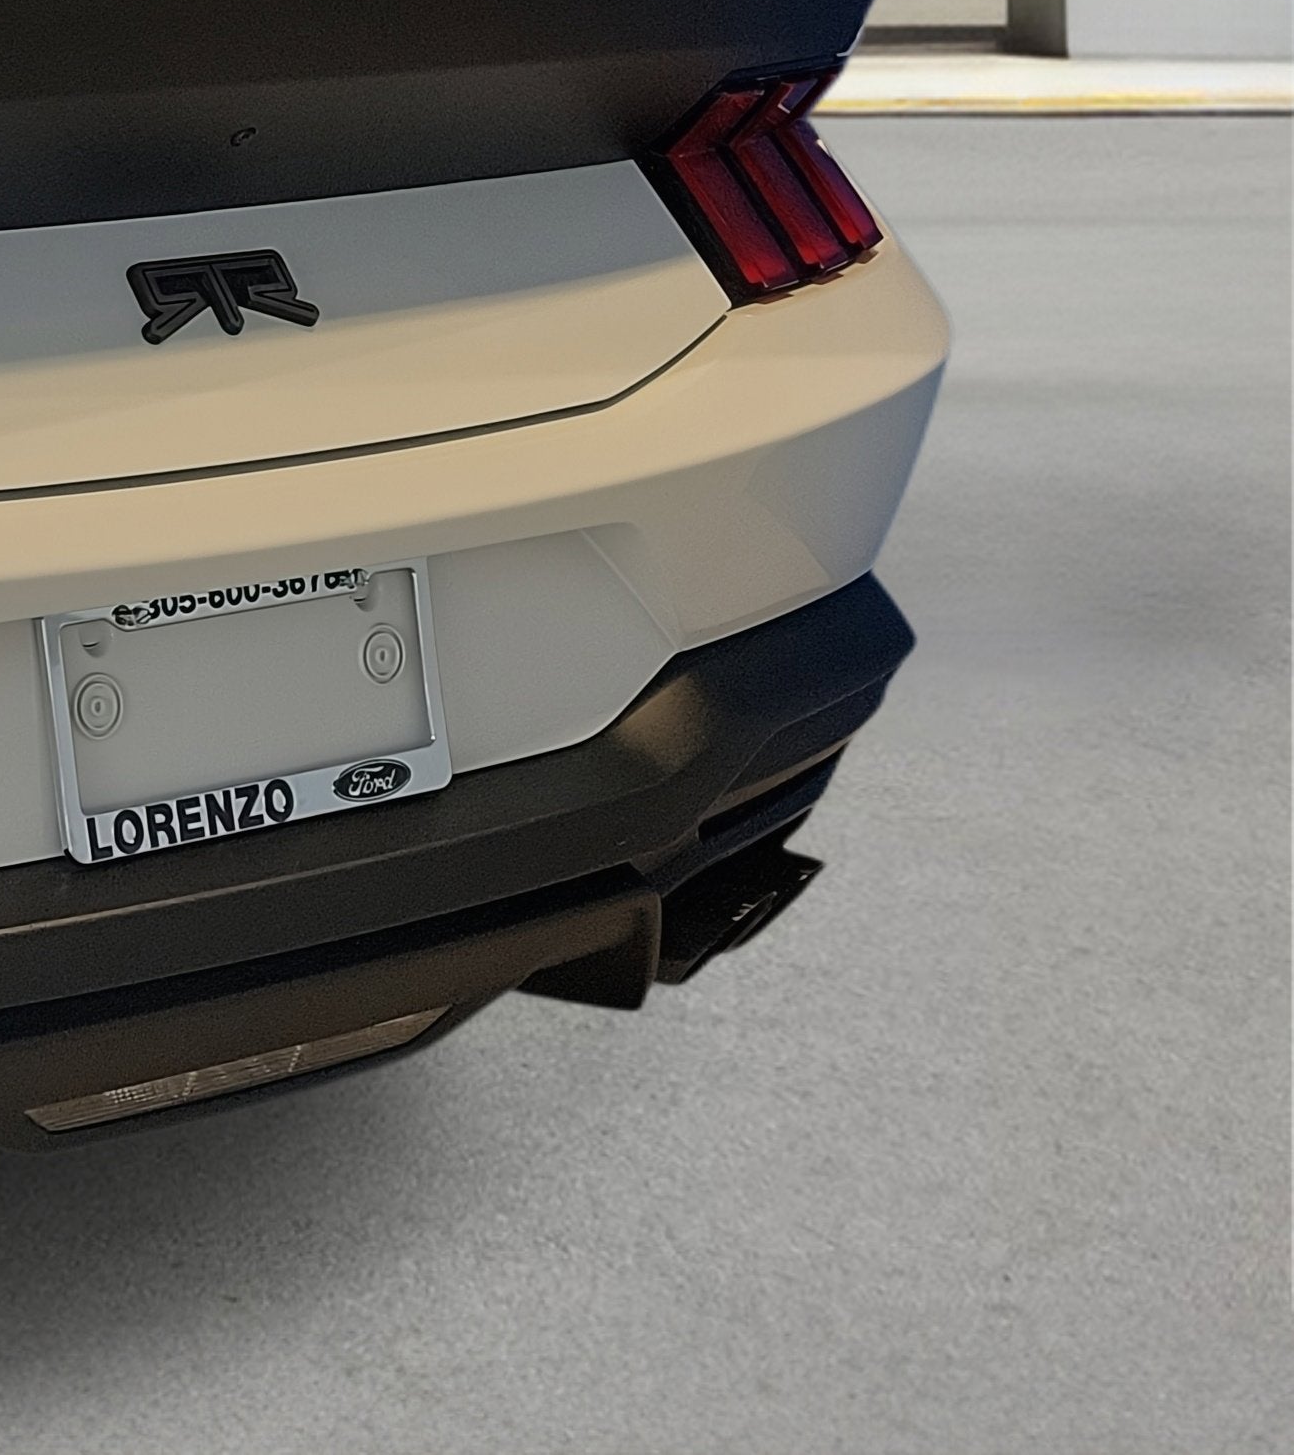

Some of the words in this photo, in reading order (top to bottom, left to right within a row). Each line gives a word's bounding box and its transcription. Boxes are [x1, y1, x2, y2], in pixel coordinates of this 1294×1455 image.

[125, 248, 321, 345] RTR
[85, 778, 295, 862] LORENZO
[348, 765, 397, 797] Ford
